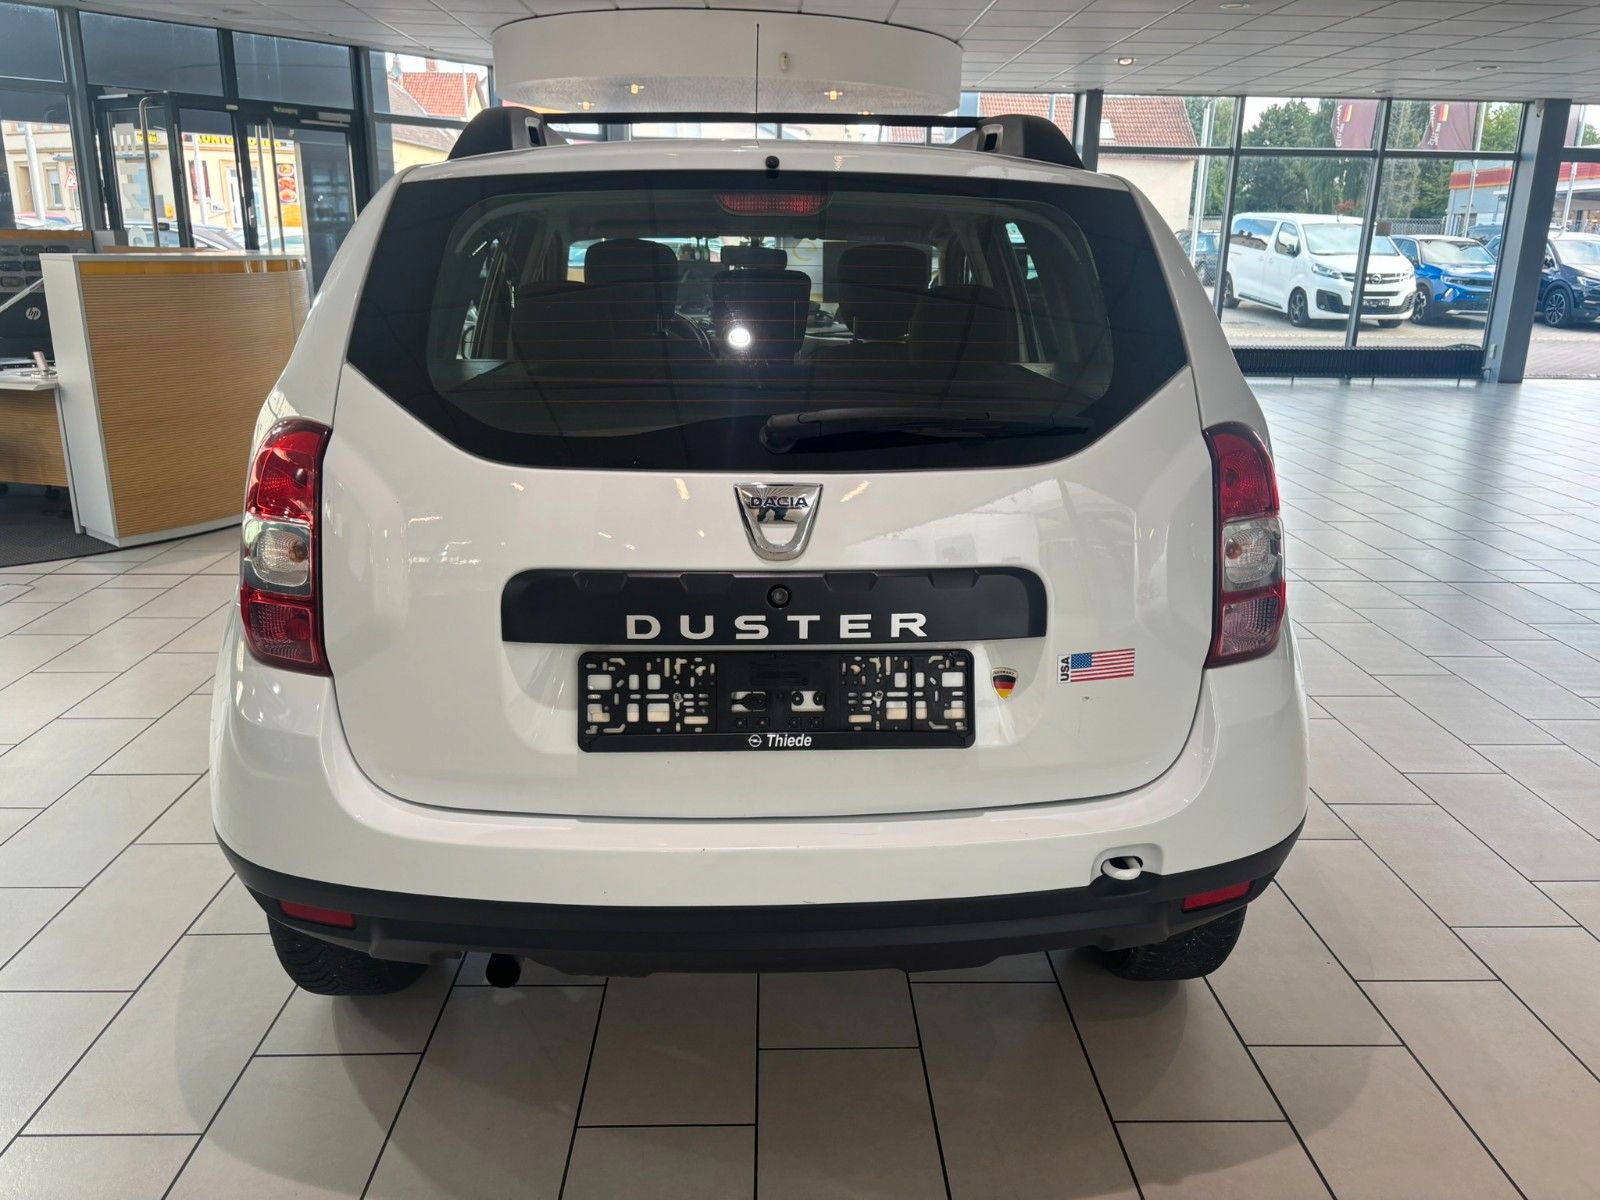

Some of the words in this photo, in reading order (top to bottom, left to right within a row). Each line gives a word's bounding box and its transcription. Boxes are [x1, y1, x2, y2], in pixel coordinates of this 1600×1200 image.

[27, 306, 39, 320] hp
[750, 496, 808, 507] DACIA
[626, 613, 928, 640] DUSTER
[1060, 656, 1070, 682] USA
[767, 734, 812, 748] Thiede
